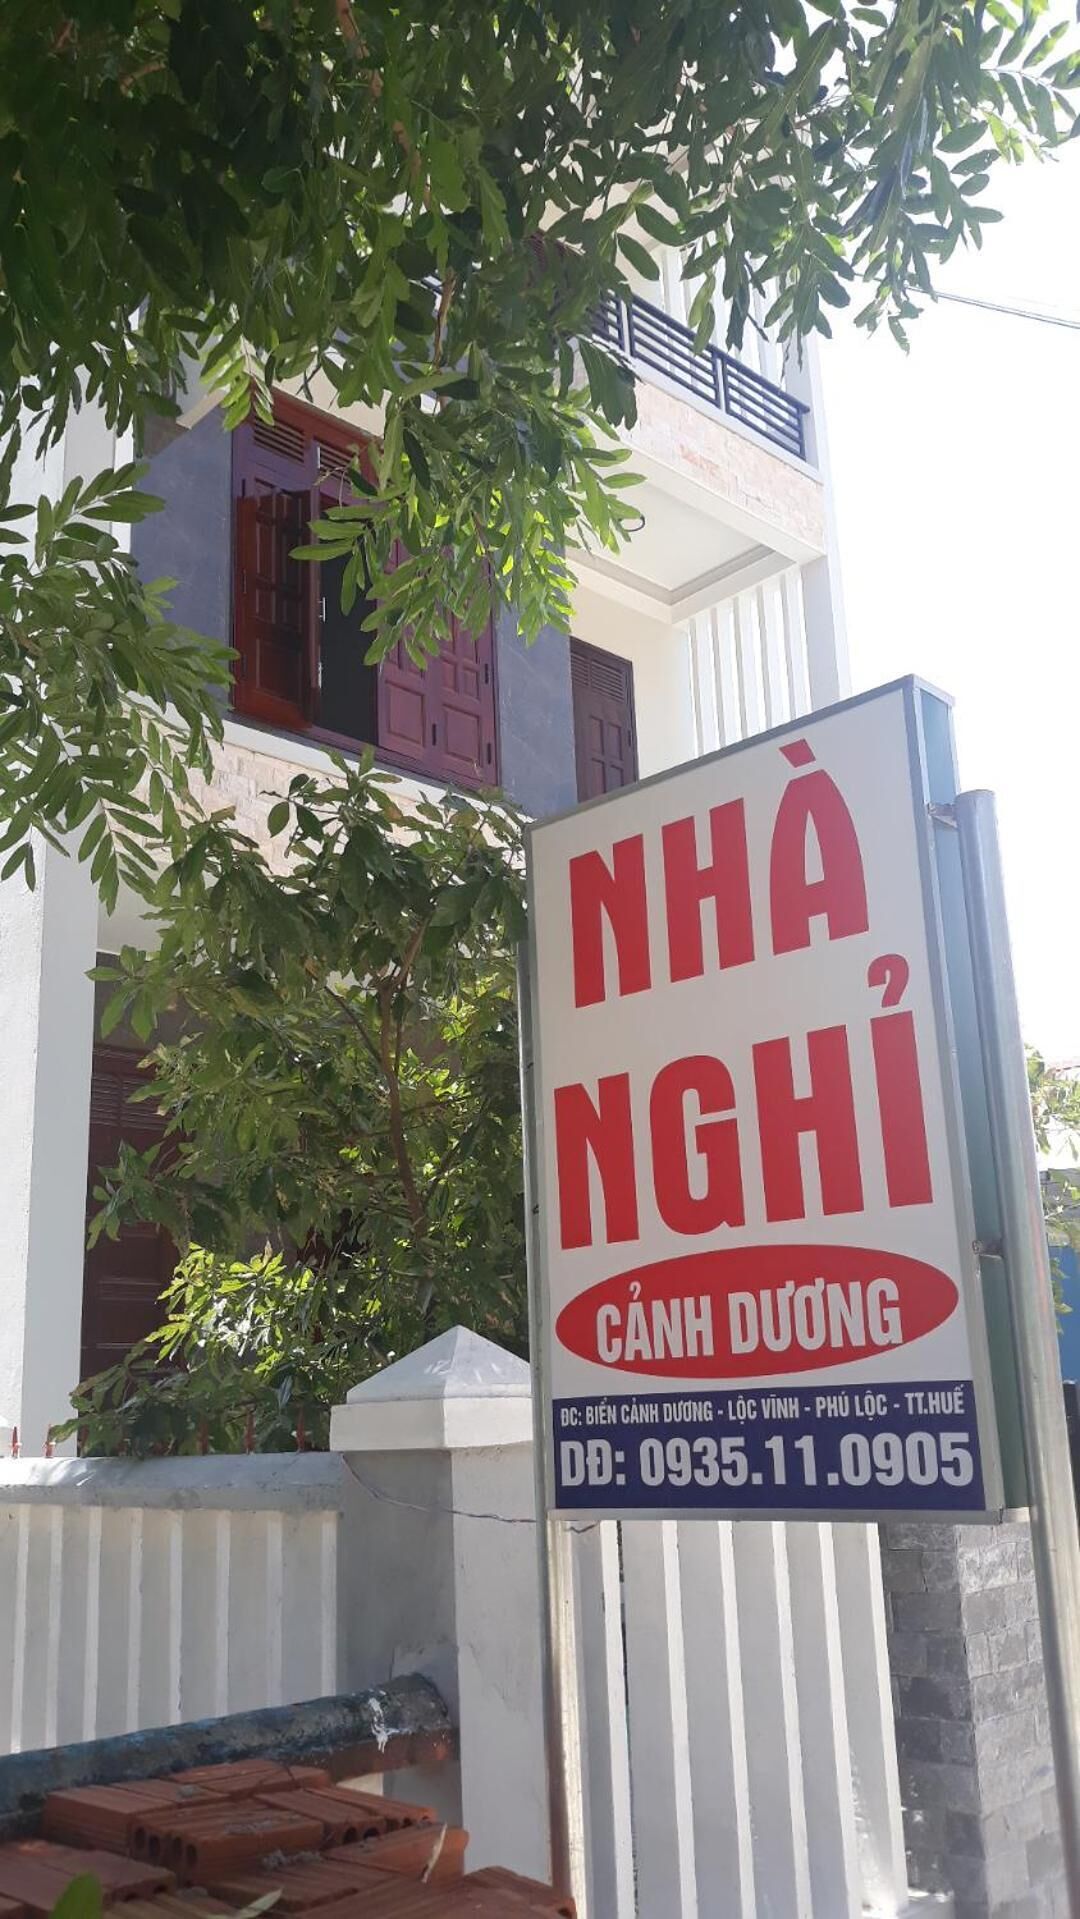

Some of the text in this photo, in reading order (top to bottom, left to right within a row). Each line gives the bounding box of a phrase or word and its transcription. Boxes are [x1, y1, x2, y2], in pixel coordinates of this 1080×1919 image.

[569, 738, 869, 1008] NHÀ
[553, 953, 933, 1250] NGHỈ
[596, 1277, 903, 1363] CẢNH DƯƠNG
[560, 1407, 582, 1426] ĐC:
[621, 1397, 659, 1423] CẢNH
[663, 1400, 713, 1422] DƯƠNG
[728, 1395, 757, 1424] LỘC
[761, 1394, 799, 1419] VĨNH
[816, 1391, 849, 1417] PHÚ
[854, 1390, 887, 1421] LỘC
[905, 1384, 964, 1415] TT.HUẾ
[560, 1431, 974, 1487] DĐ: 0935.11.0905
